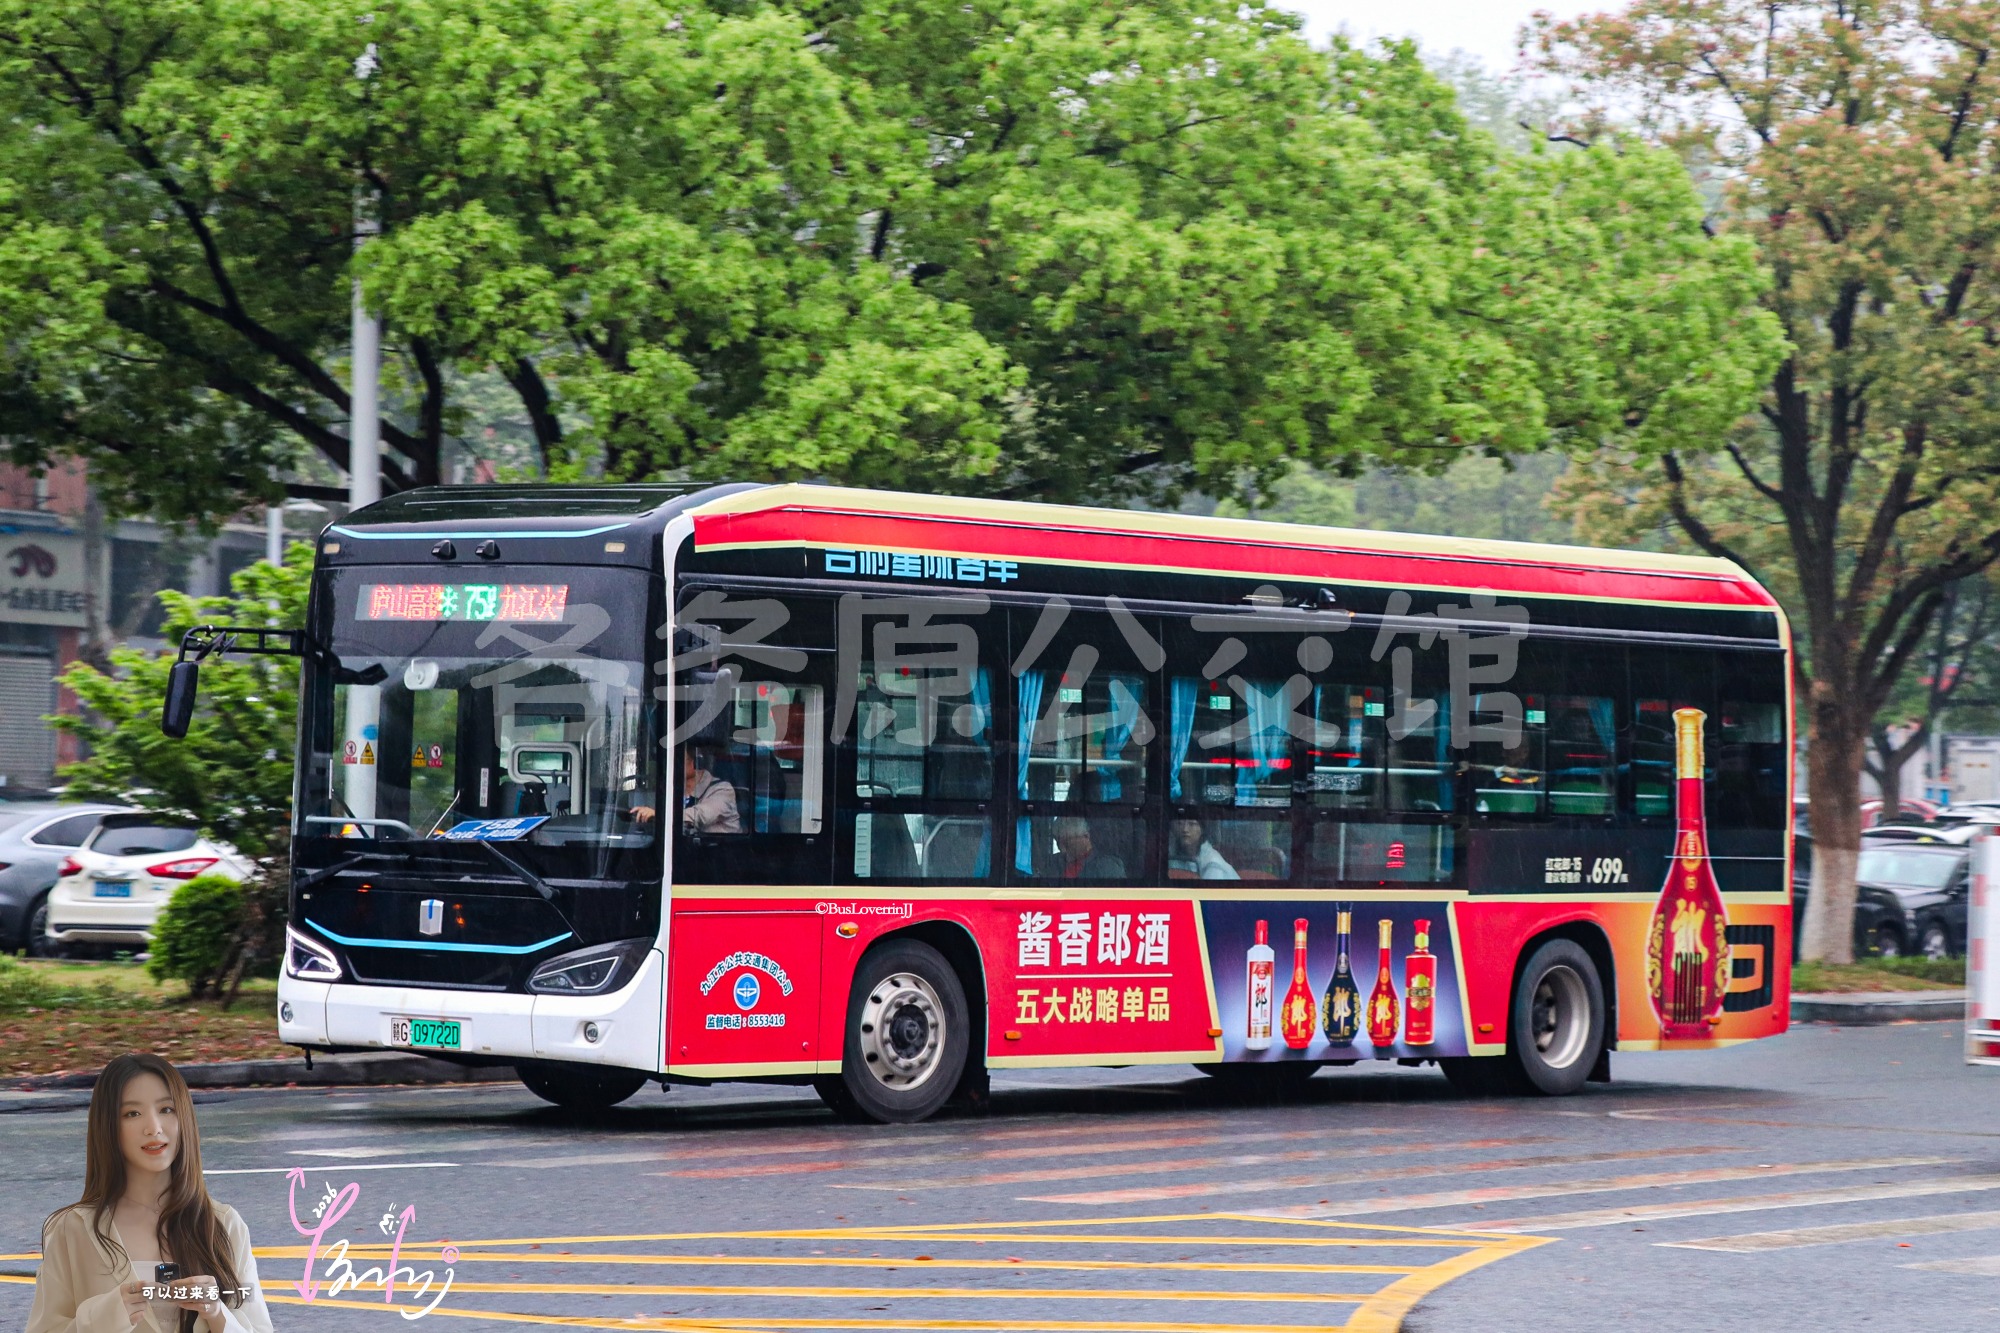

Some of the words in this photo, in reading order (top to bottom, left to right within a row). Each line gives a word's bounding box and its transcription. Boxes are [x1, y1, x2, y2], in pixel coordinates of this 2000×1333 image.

[1017, 911, 1171, 967] 酱香郎酒
[700, 951, 793, 996] 九江市公共交通集团公司
[1015, 986, 1170, 1024] 五大战略单品
